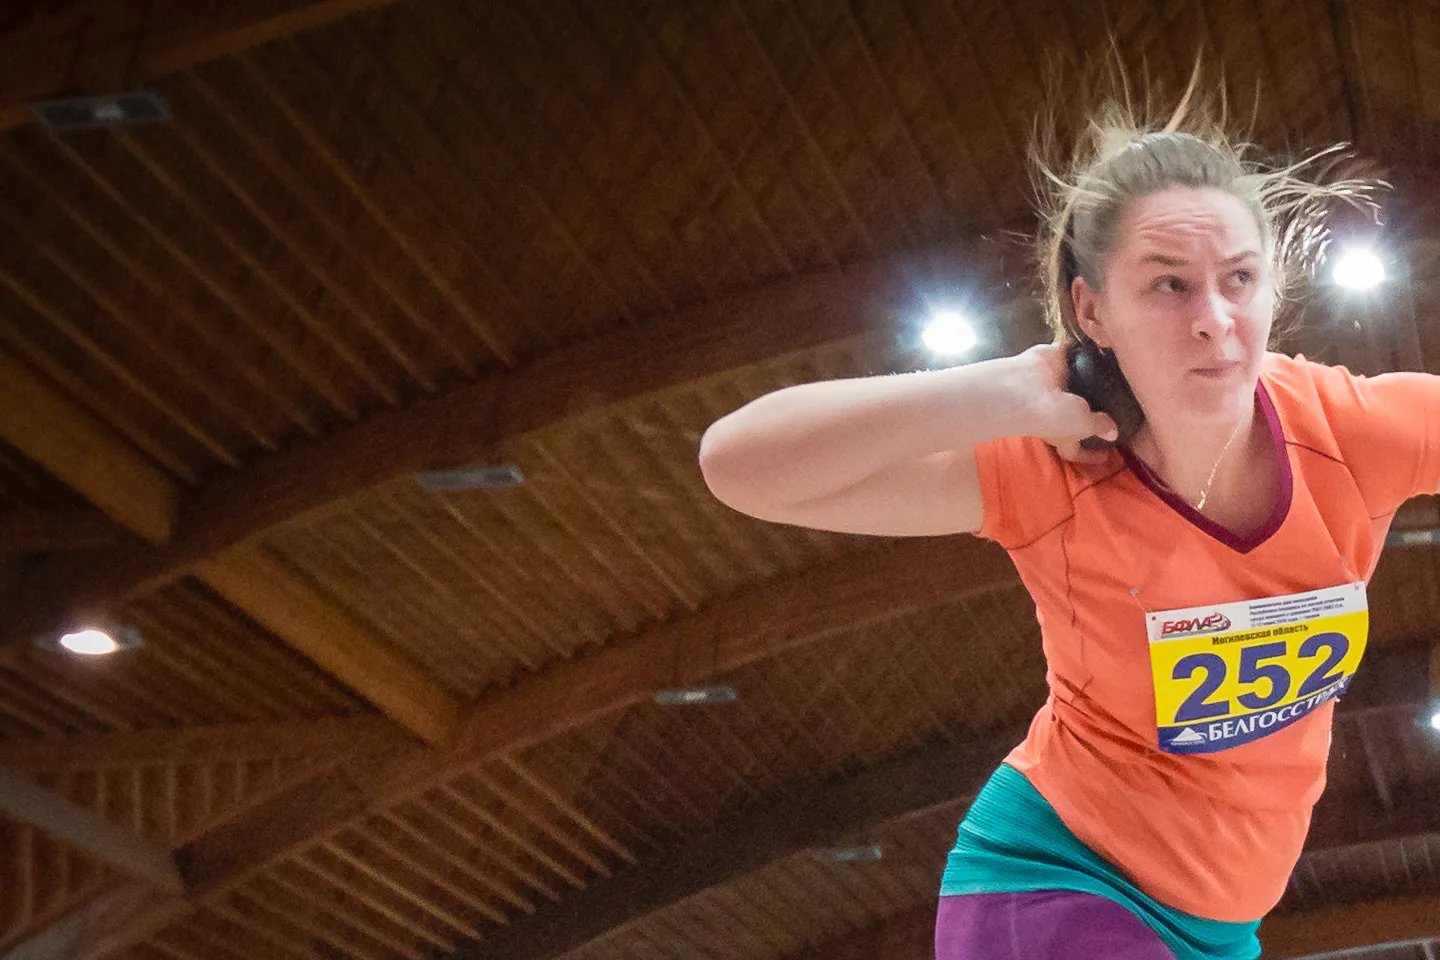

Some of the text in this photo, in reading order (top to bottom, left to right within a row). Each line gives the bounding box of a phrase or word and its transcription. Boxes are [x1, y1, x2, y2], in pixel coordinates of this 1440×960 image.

[1212, 624, 1309, 645] Могилевская область
[1172, 632, 1350, 723] 252
